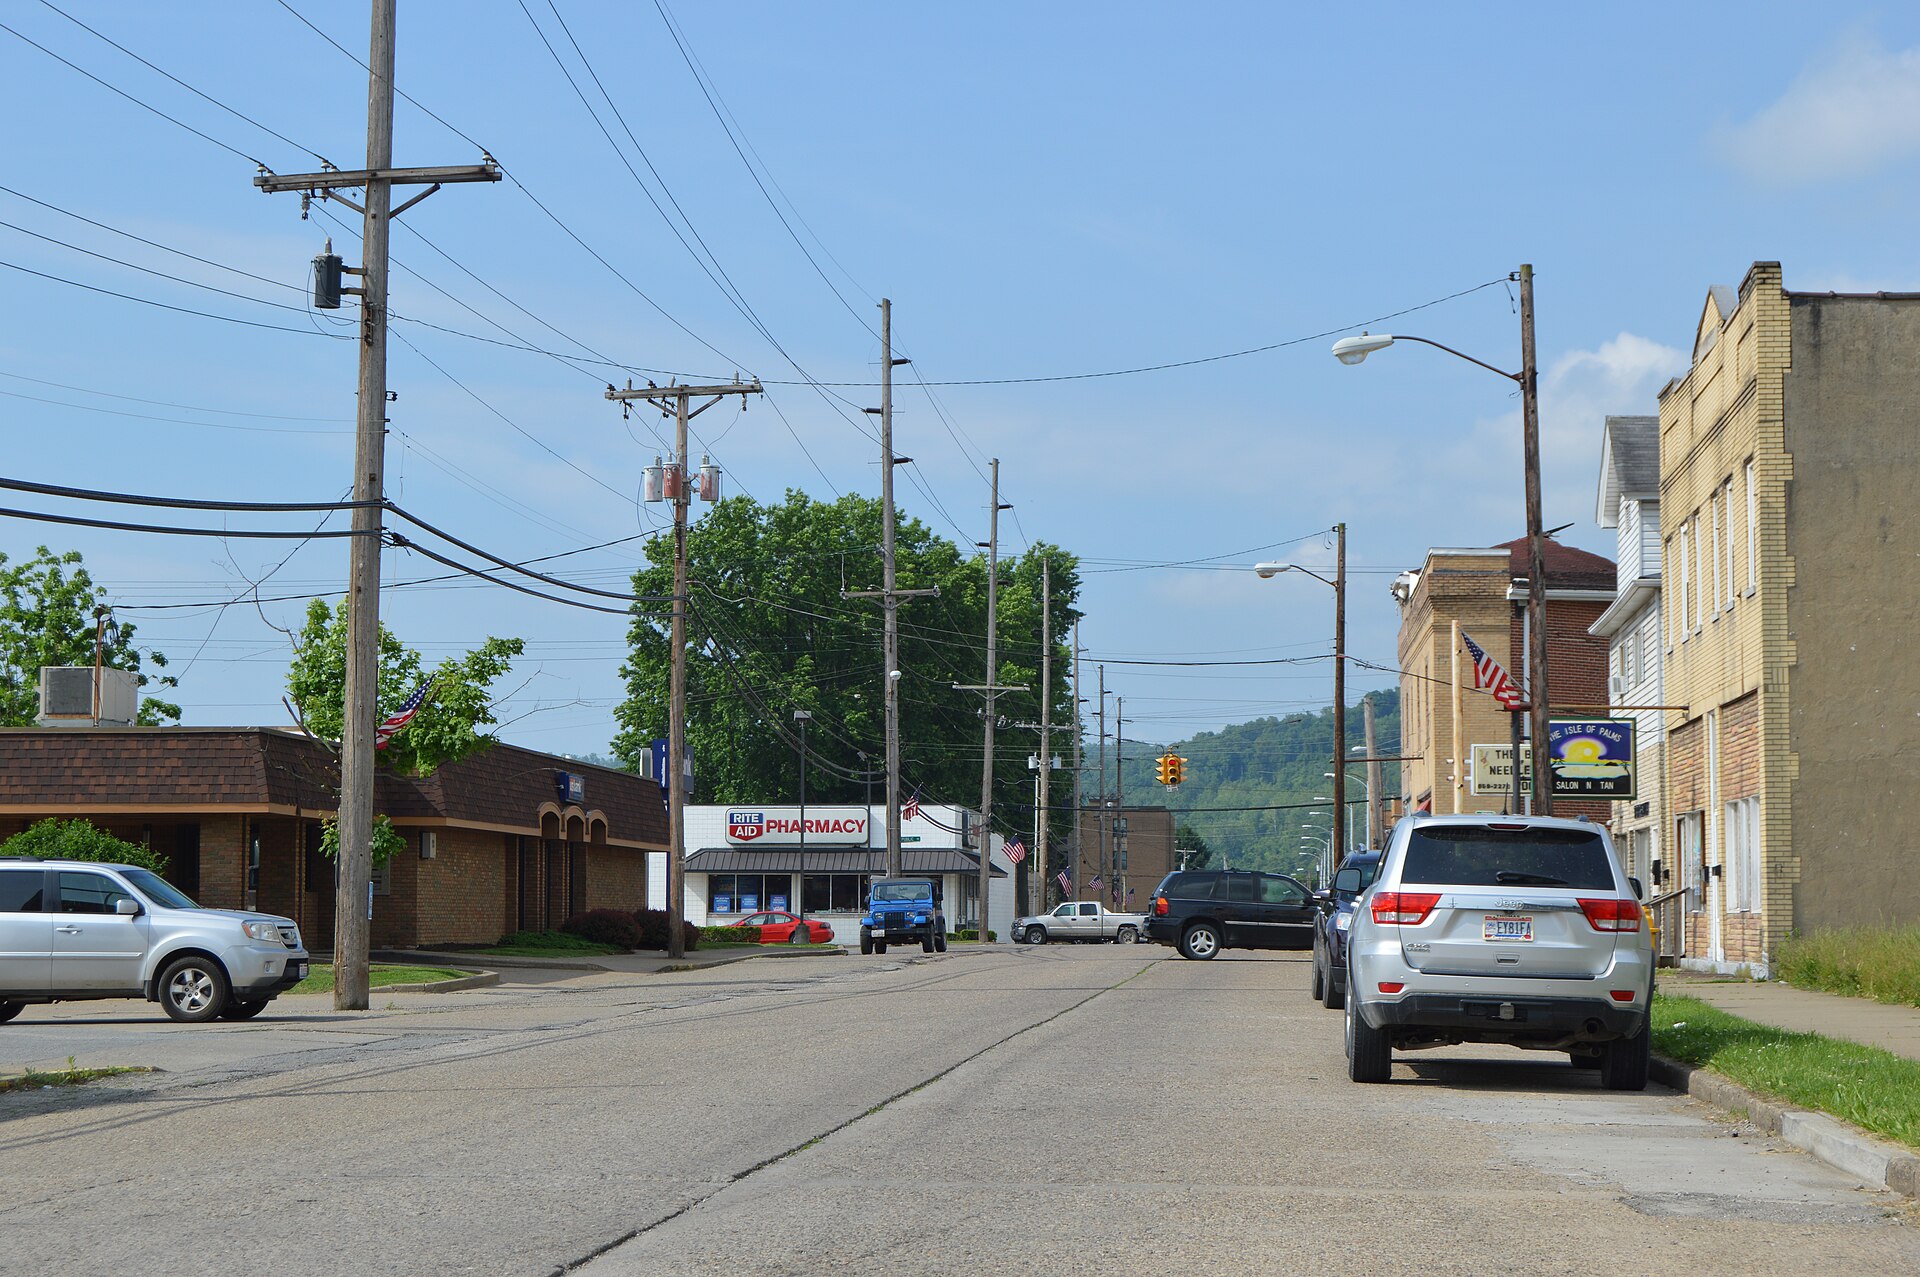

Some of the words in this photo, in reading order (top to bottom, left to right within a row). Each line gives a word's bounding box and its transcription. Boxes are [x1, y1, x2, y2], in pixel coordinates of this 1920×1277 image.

[1564, 725, 1583, 735] ISLE
[1586, 725, 1596, 733] OF
[1599, 727, 1622, 742] PALMS
[1556, 781, 1579, 789] SALON
[1586, 781, 1592, 789] N
[1600, 781, 1614, 789] TAN
[733, 813, 760, 823] RITE
[735, 826, 757, 837] AID
[766, 819, 866, 834] PHARMACY
[1494, 897, 1525, 910] Jeep
[1497, 921, 1532, 934] EY81FA
